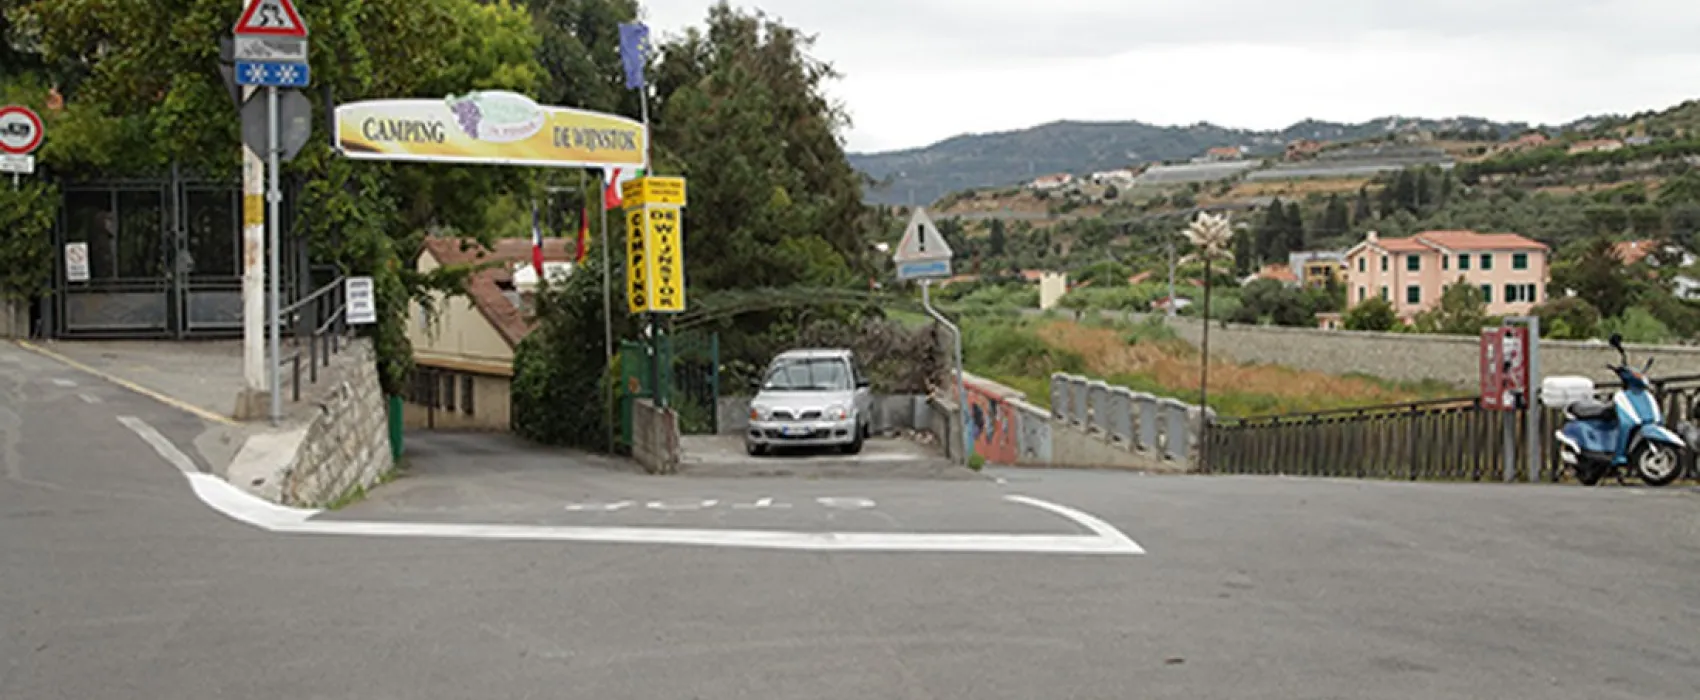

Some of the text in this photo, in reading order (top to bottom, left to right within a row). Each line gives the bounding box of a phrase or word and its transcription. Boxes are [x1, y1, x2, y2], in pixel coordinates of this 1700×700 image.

[362, 117, 445, 143] CAMPING
[553, 126, 570, 148] DE
[650, 210, 674, 220] DE
